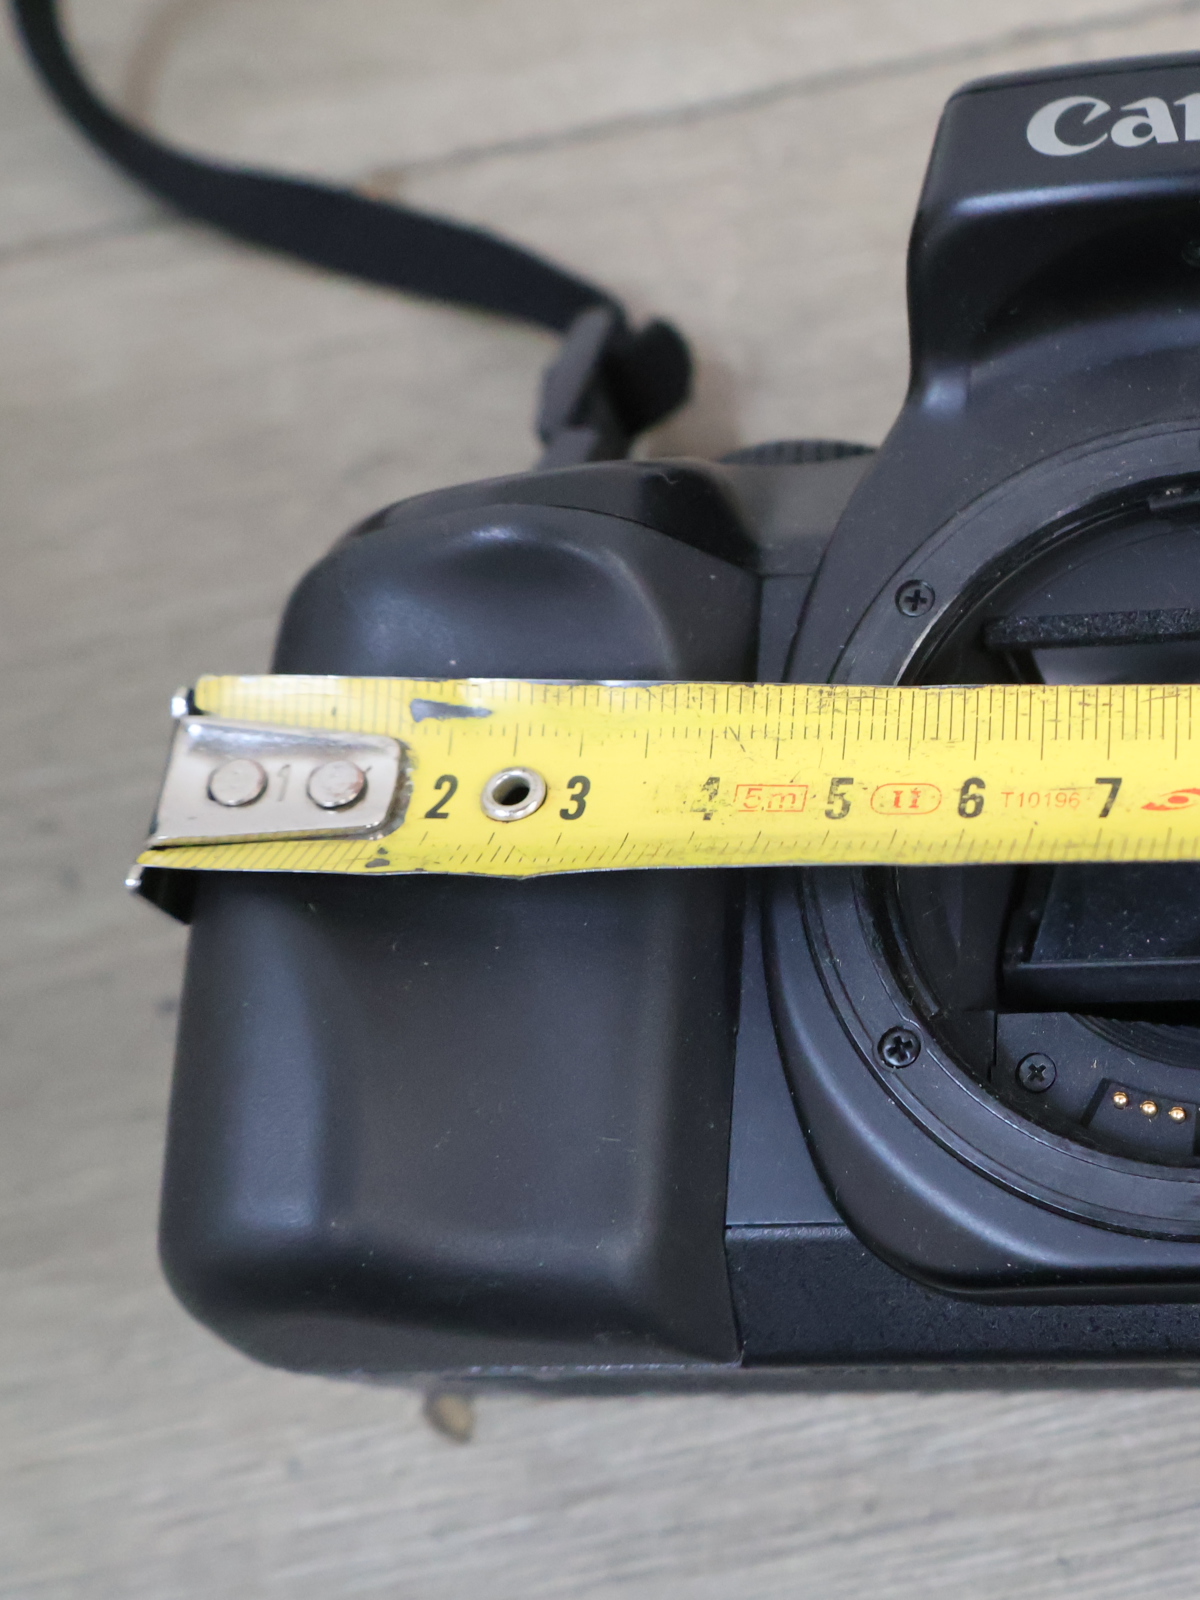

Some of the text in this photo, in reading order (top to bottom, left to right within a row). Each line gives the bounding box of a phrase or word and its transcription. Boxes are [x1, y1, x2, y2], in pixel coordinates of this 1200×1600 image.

[424, 774, 459, 819] 2
[559, 775, 592, 820] 3
[824, 777, 854, 820] 5
[957, 777, 986, 819] 6
[1001, 790, 1081, 809] T10196
[1095, 777, 1123, 818] 7
